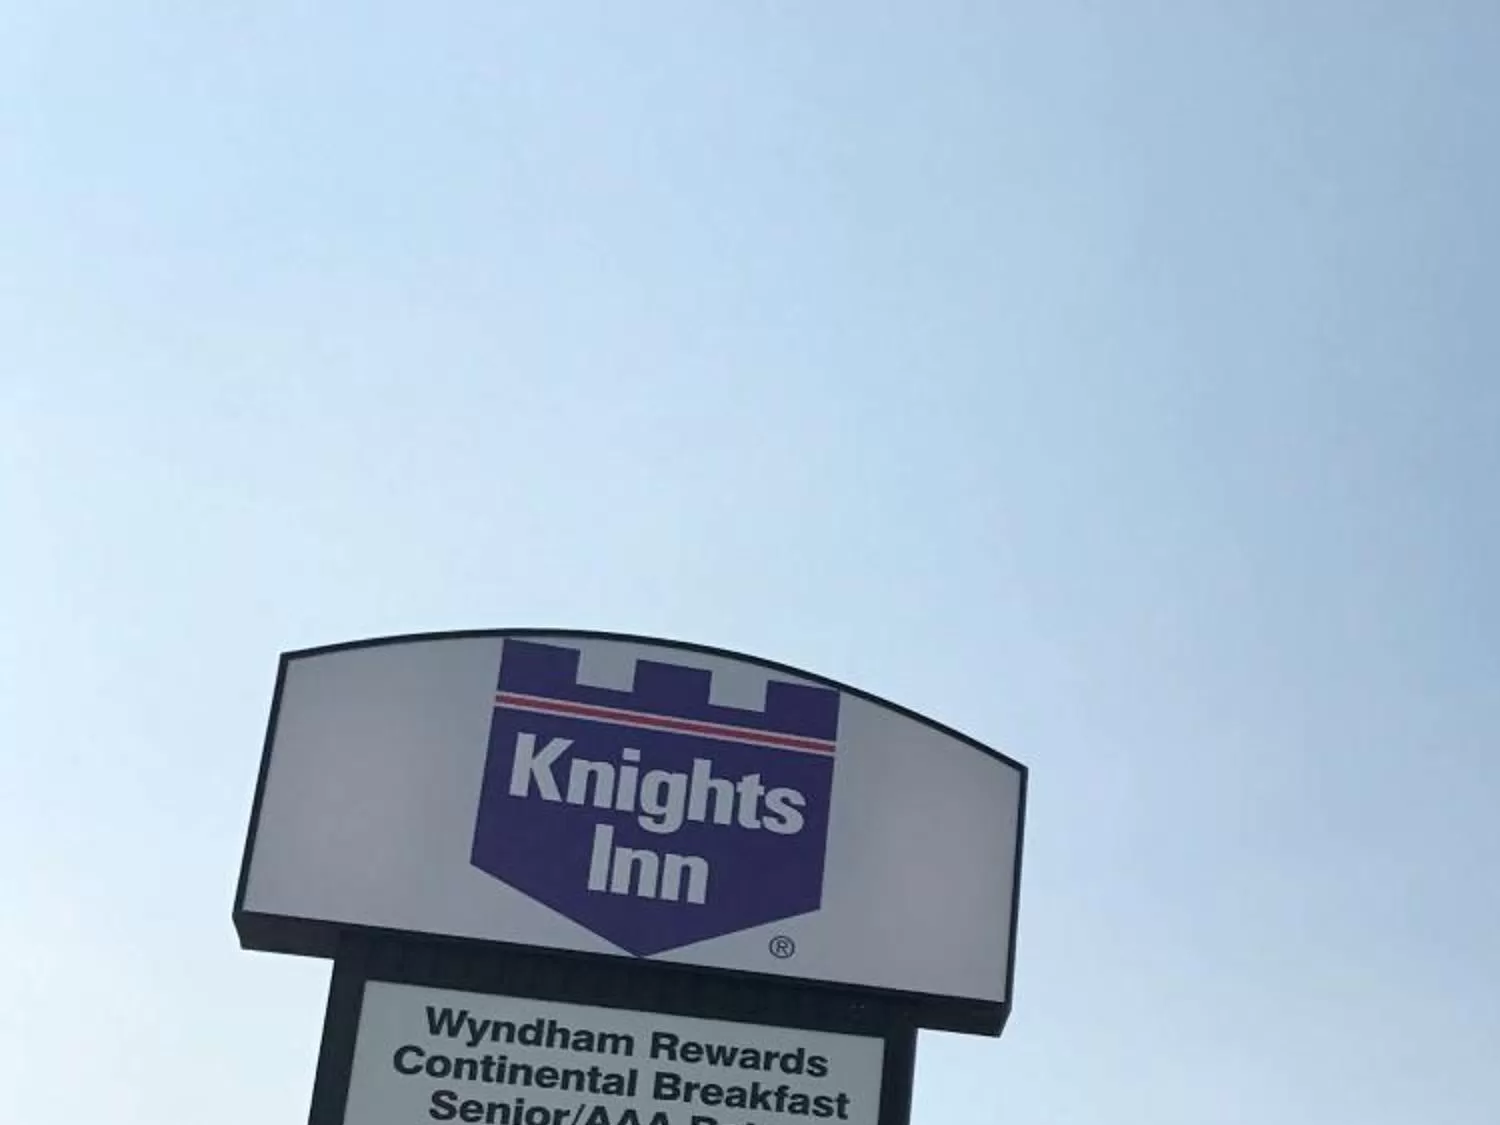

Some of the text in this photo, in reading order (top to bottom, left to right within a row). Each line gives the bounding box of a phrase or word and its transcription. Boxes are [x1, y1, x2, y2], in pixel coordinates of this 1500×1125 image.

[508, 731, 806, 835] Knights
[587, 823, 709, 905] Inn
[425, 1005, 829, 1078] Wyndham Rewards
[393, 1044, 851, 1120] Continental Breakfast
